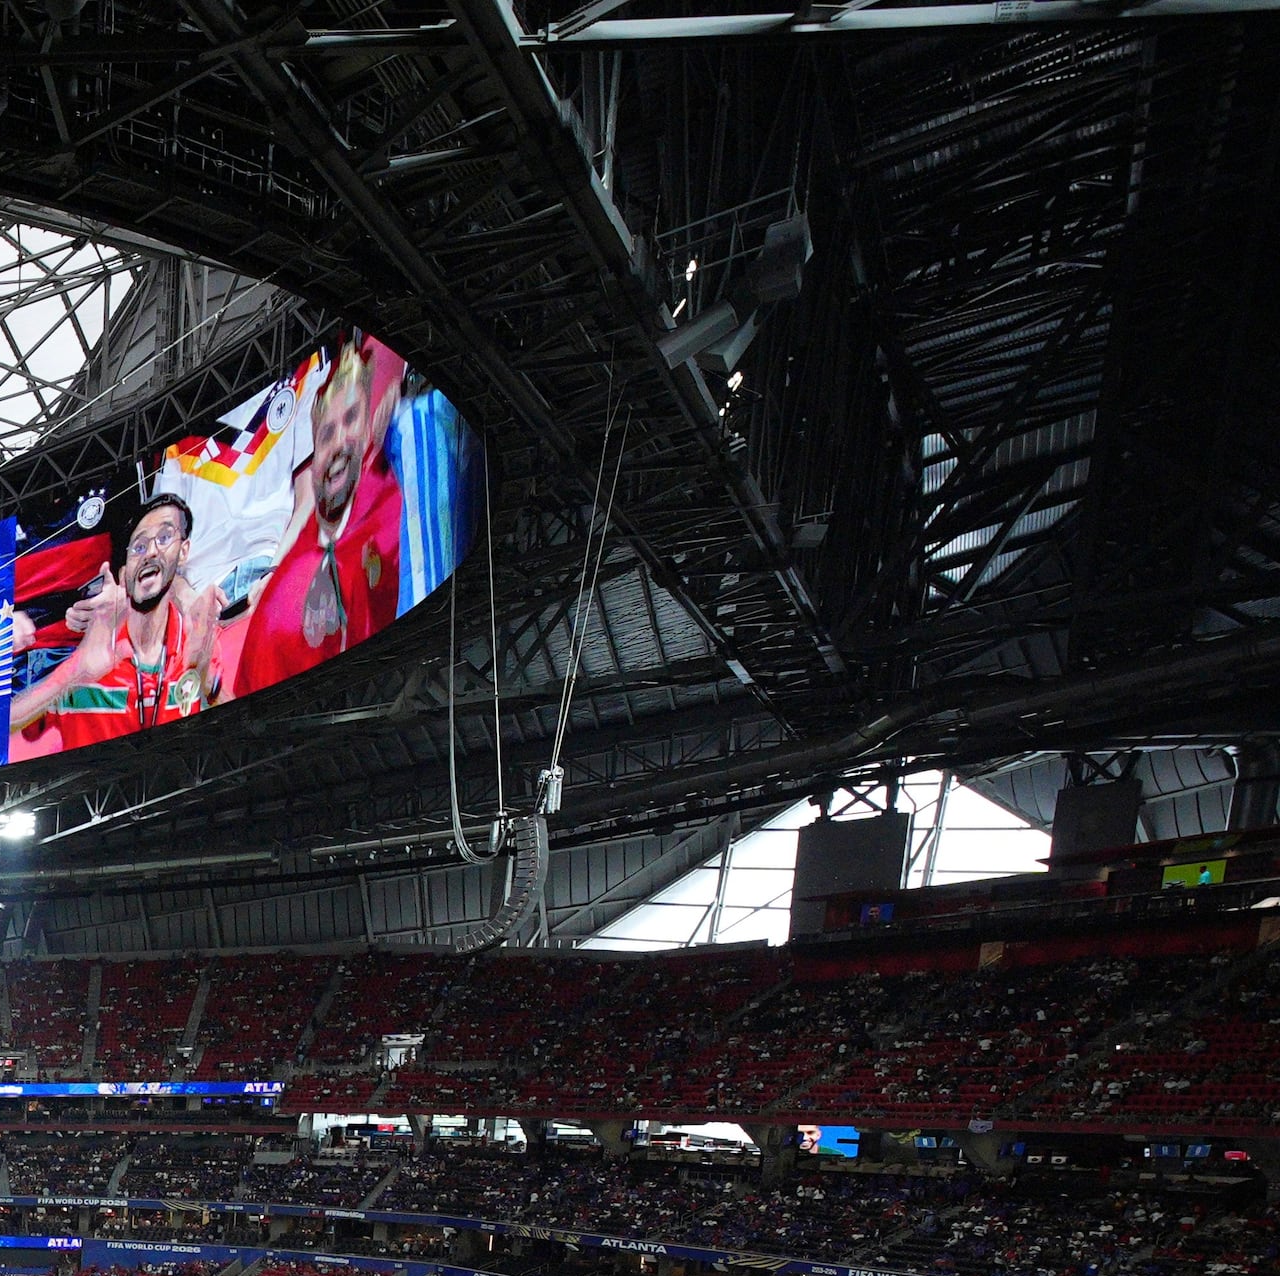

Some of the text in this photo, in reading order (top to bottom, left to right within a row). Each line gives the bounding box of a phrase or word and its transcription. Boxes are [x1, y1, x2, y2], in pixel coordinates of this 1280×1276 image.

[107, 1242, 201, 1254] FIFA WORLD CUP 2026
[601, 1239, 667, 1255] ATLANTA
